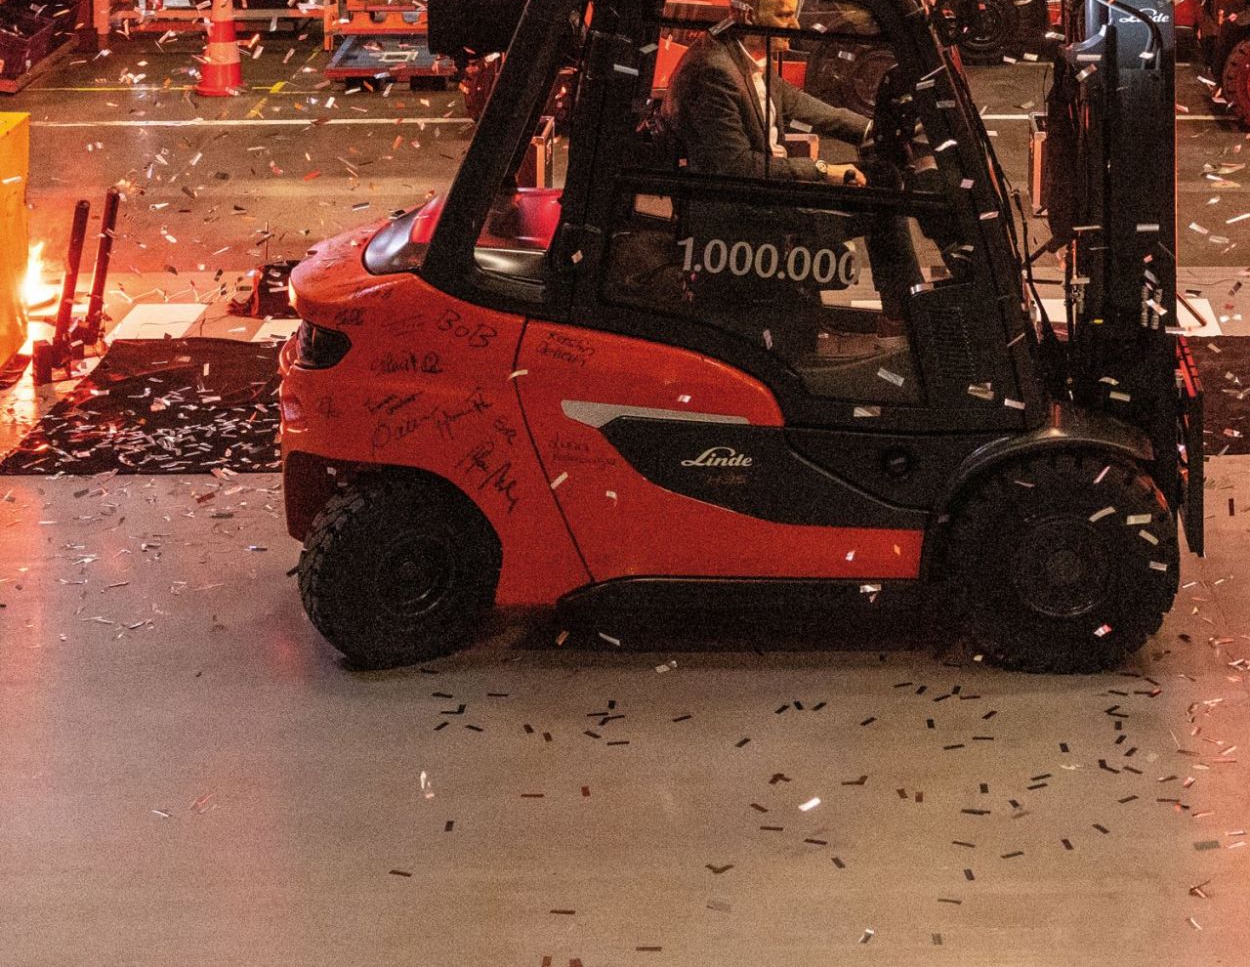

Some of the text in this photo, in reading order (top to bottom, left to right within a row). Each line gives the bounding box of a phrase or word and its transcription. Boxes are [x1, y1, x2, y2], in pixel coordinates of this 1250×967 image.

[1119, 8, 1170, 22] Lde
[677, 237, 861, 285] 1.000.000
[680, 446, 753, 467] Linde
